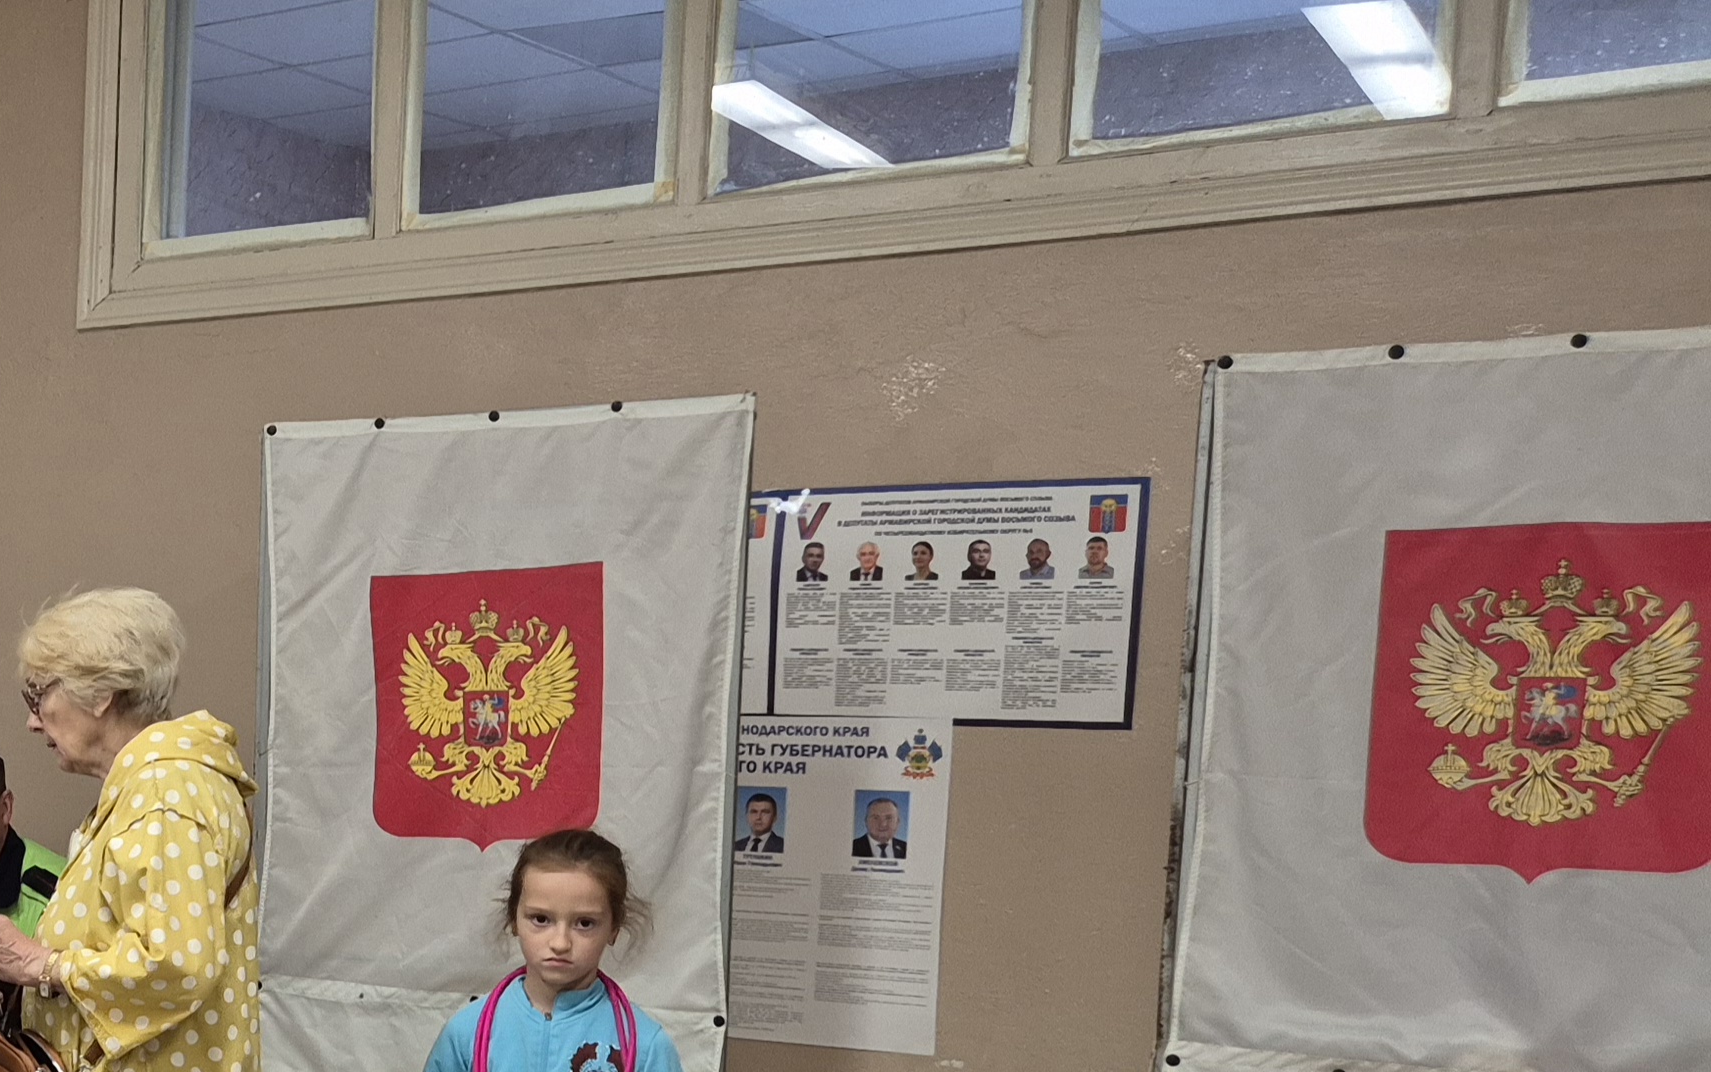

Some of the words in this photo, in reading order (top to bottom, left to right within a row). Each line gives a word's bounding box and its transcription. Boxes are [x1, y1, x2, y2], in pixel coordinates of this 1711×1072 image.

[833, 726, 870, 737] КРАЯ
[771, 743, 888, 759] ГУБЕРНАТОРА
[763, 761, 806, 774] КРАЯ
